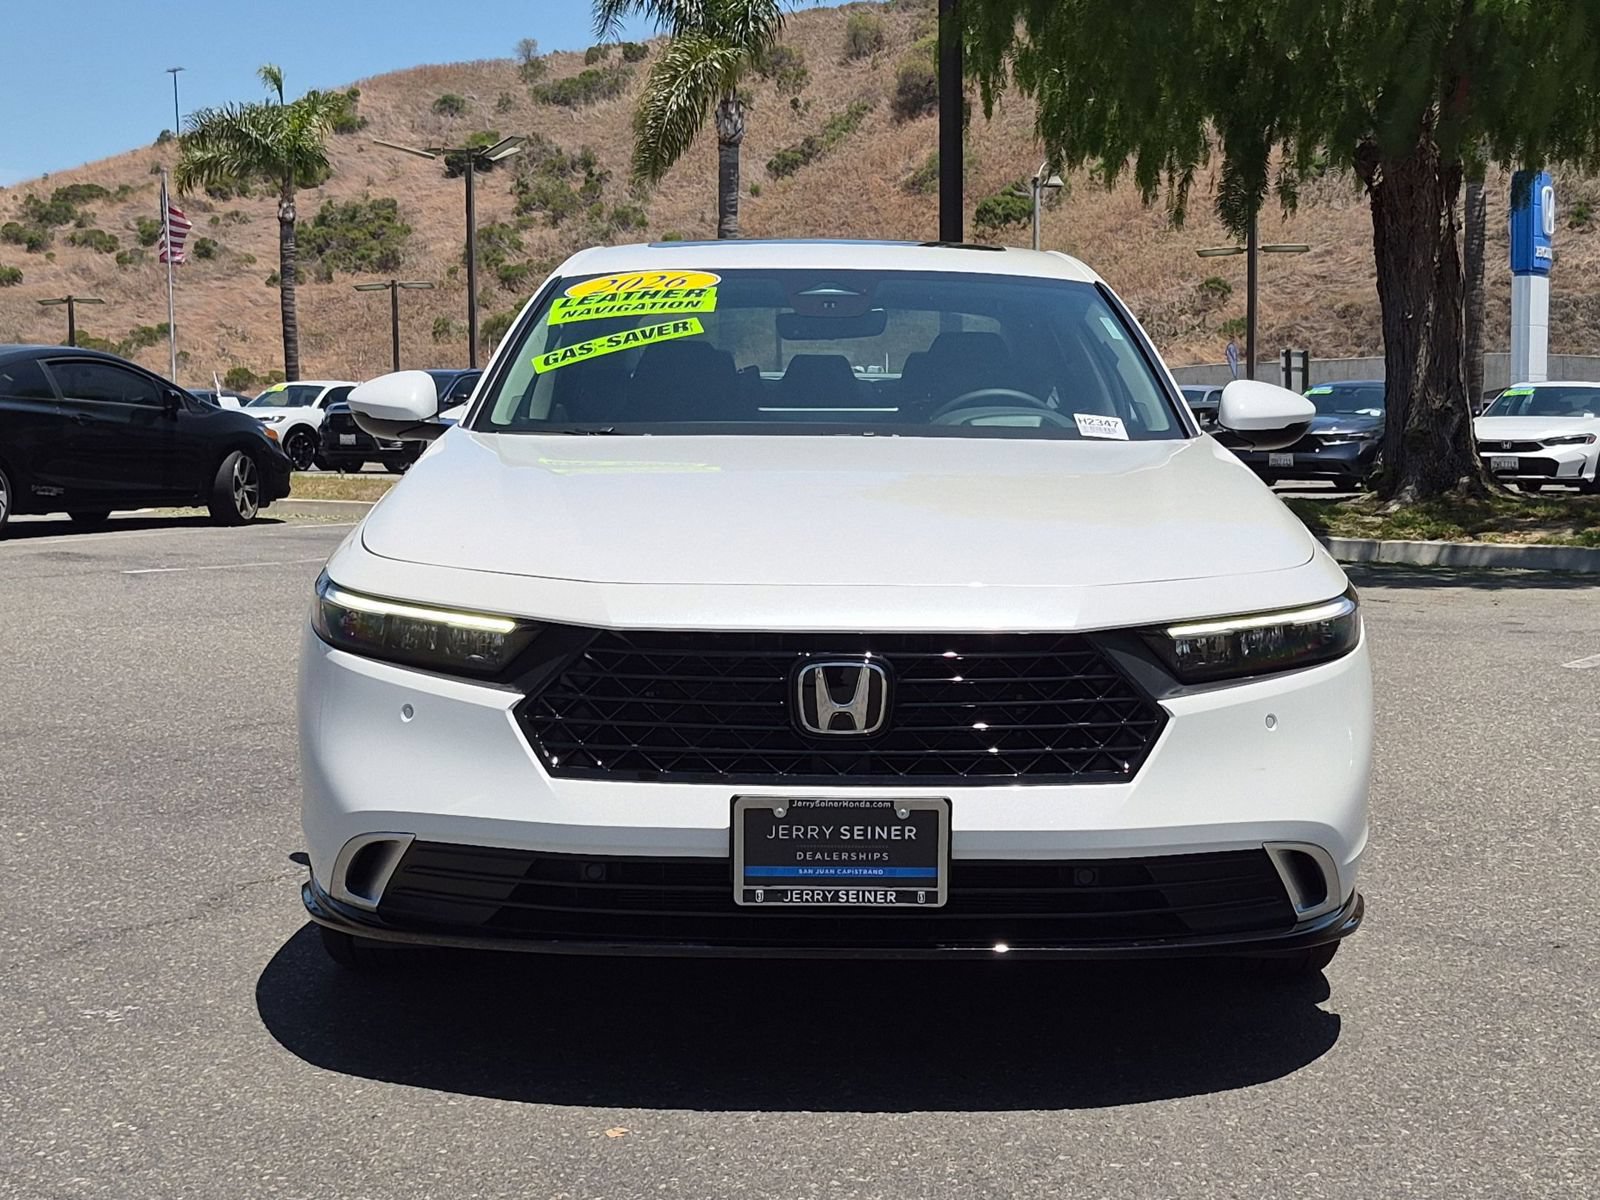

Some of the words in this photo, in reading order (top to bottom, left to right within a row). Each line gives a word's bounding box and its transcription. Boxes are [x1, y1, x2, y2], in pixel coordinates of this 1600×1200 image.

[589, 273, 687, 295] 2026
[559, 288, 708, 309] LEATHER
[561, 300, 702, 319] NAVIGATION
[543, 321, 690, 367] GAS-SAVER
[1078, 417, 1119, 428] H2347
[792, 800, 891, 809] JerrySeinerHonda.com
[766, 825, 835, 840] JERRY
[839, 825, 918, 840] SEINER
[796, 851, 890, 862] DEALERSHIPS
[783, 890, 835, 903] JERRY
[838, 891, 897, 903] SEINER
